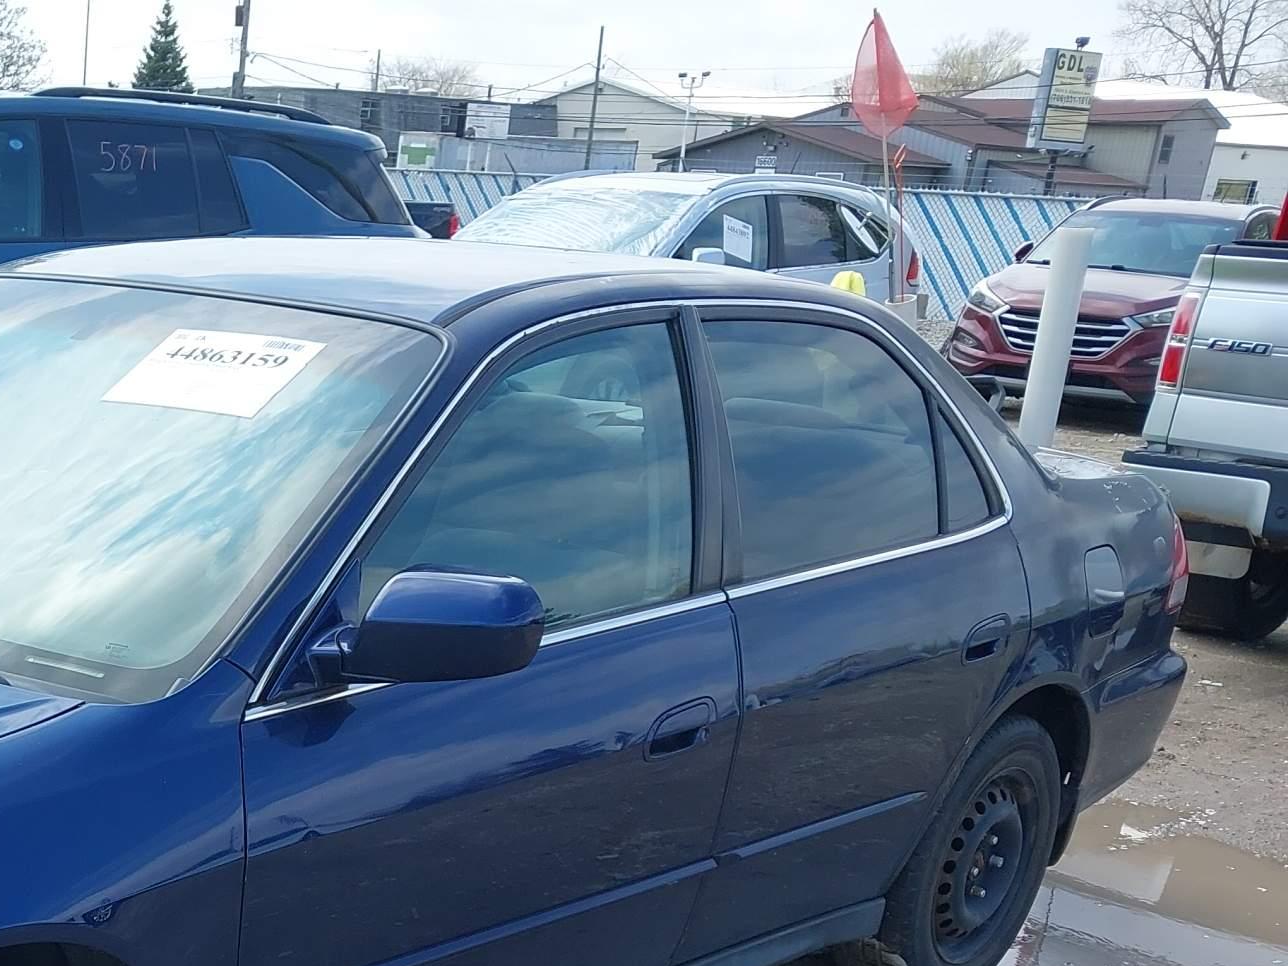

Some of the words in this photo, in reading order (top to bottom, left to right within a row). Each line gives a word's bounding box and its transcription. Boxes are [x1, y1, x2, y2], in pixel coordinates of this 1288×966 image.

[1057, 53, 1084, 72] GDL
[100, 141, 157, 172] 5871
[166, 346, 289, 368] 44863159
